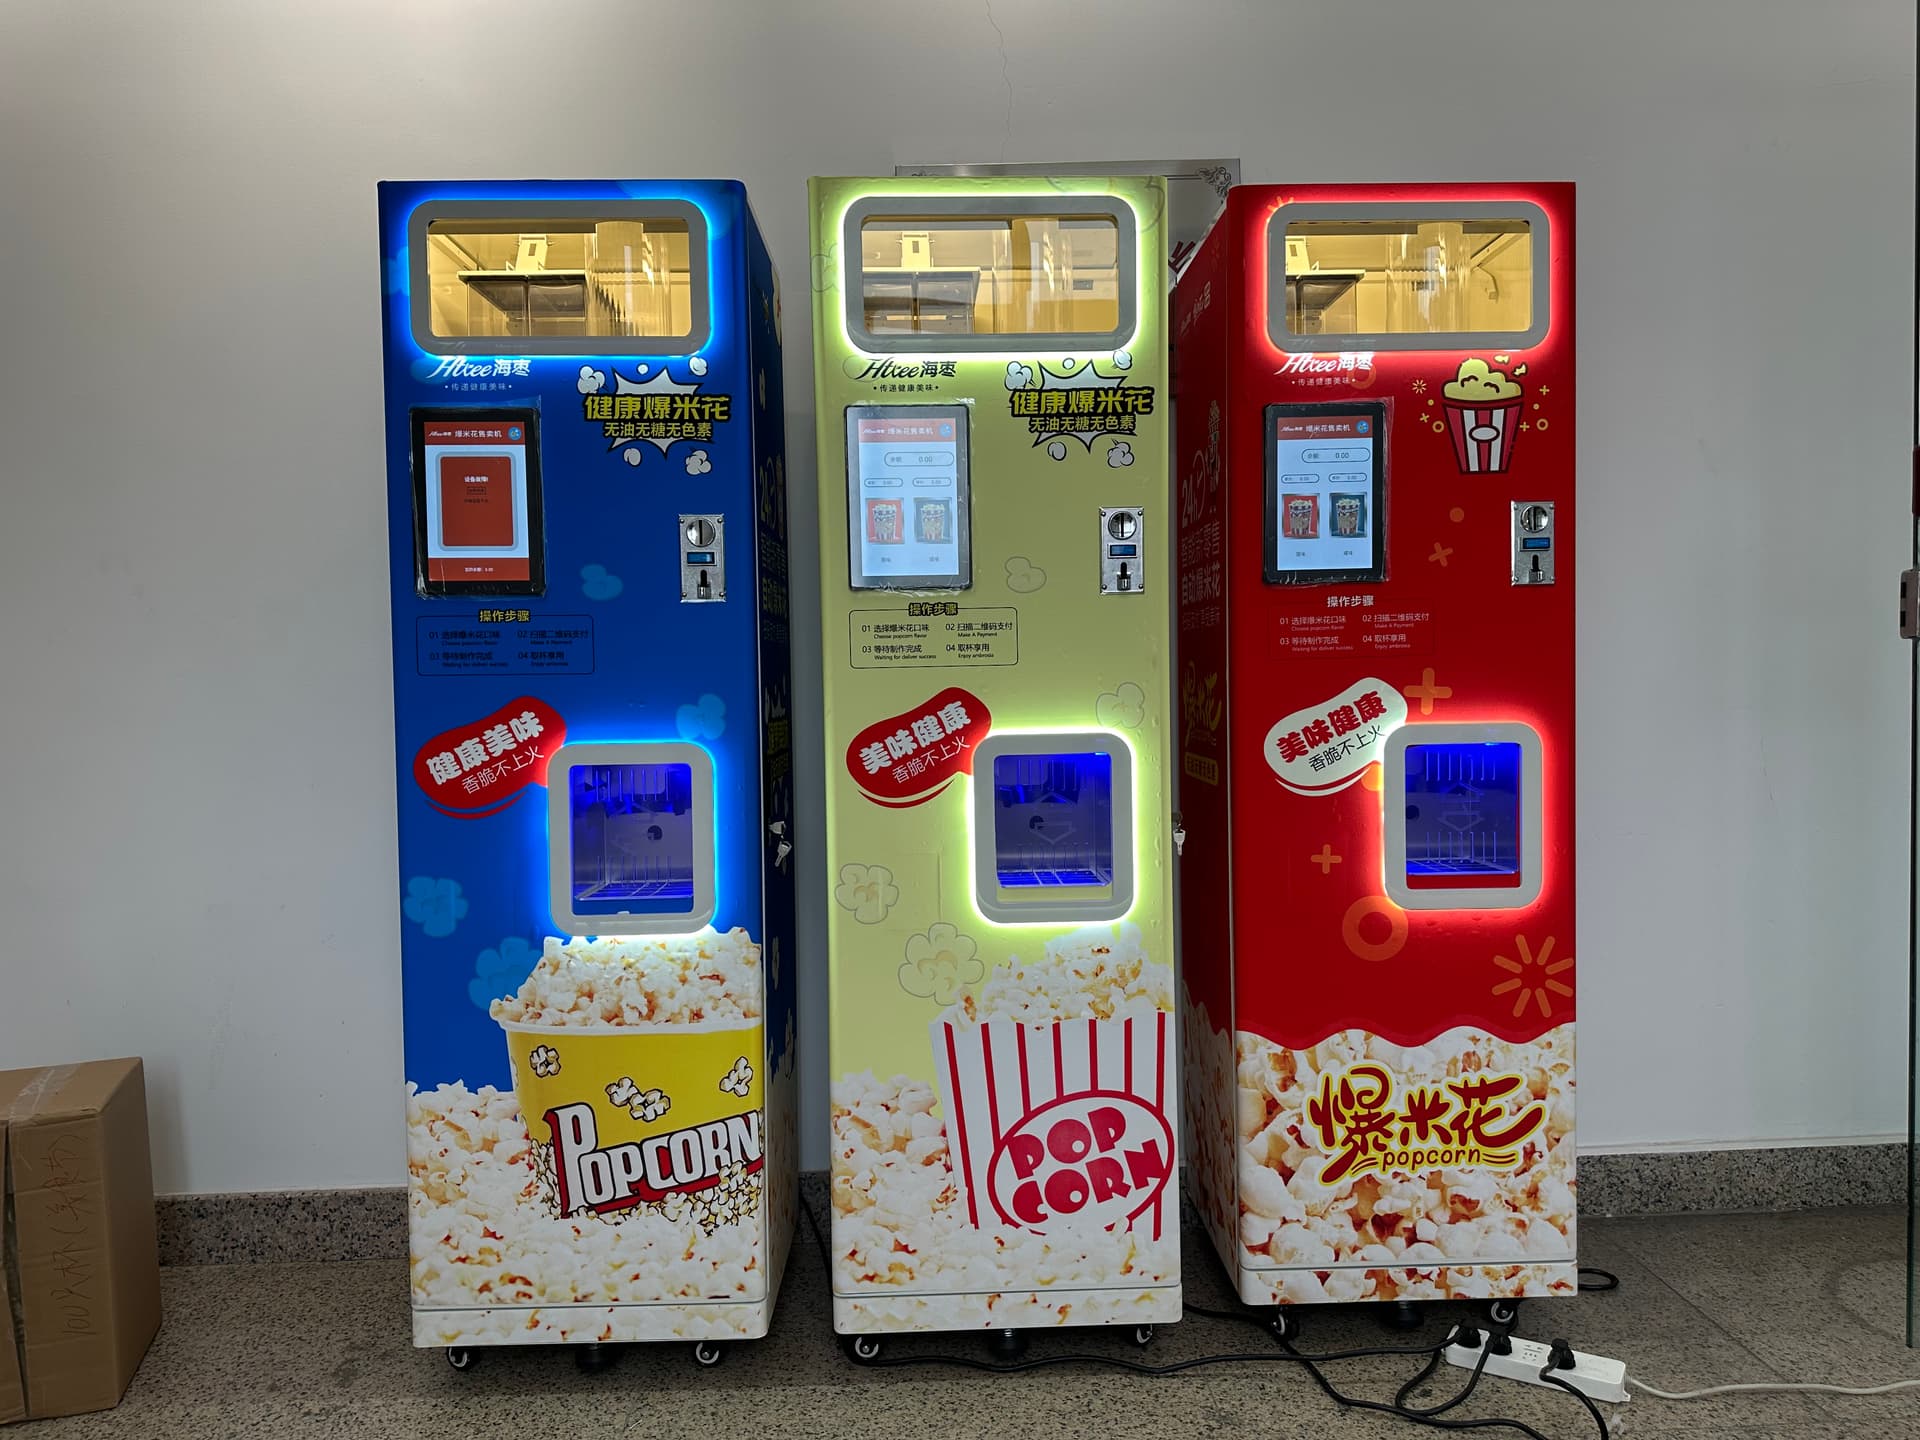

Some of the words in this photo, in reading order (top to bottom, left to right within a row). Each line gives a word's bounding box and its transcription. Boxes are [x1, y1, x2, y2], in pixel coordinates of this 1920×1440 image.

[492, 359, 531, 377] 海枣
[919, 360, 957, 378] 海枣
[880, 383, 934, 393] 传递健康美味
[584, 395, 730, 420] 健康爆米花
[1012, 389, 1152, 415] 健康爆米花
[604, 422, 712, 437] 无油无糖无色素
[1031, 415, 1135, 431] 无油无糖无色素
[908, 602, 959, 616] 操作步骤
[1327, 595, 1374, 608] 操作步骤
[479, 609, 531, 622] 操作步骤
[957, 622, 1012, 631] 扫描二维码支付
[874, 645, 922, 654] 等待制作完成
[958, 644, 989, 652] 取杯享用
[858, 701, 972, 774] 美味健康
[1276, 690, 1387, 763] 美味健康
[426, 711, 544, 785] 健康美味
[892, 736, 970, 784] 香脆不上火
[1308, 724, 1385, 772] 香脆不上火
[462, 746, 544, 794] 香脆不上火
[1308, 1065, 1544, 1184] 爆米花
[1007, 1106, 1126, 1180] POP
[1382, 1148, 1481, 1172] popcorn
[1012, 1138, 1166, 1224] CORN
